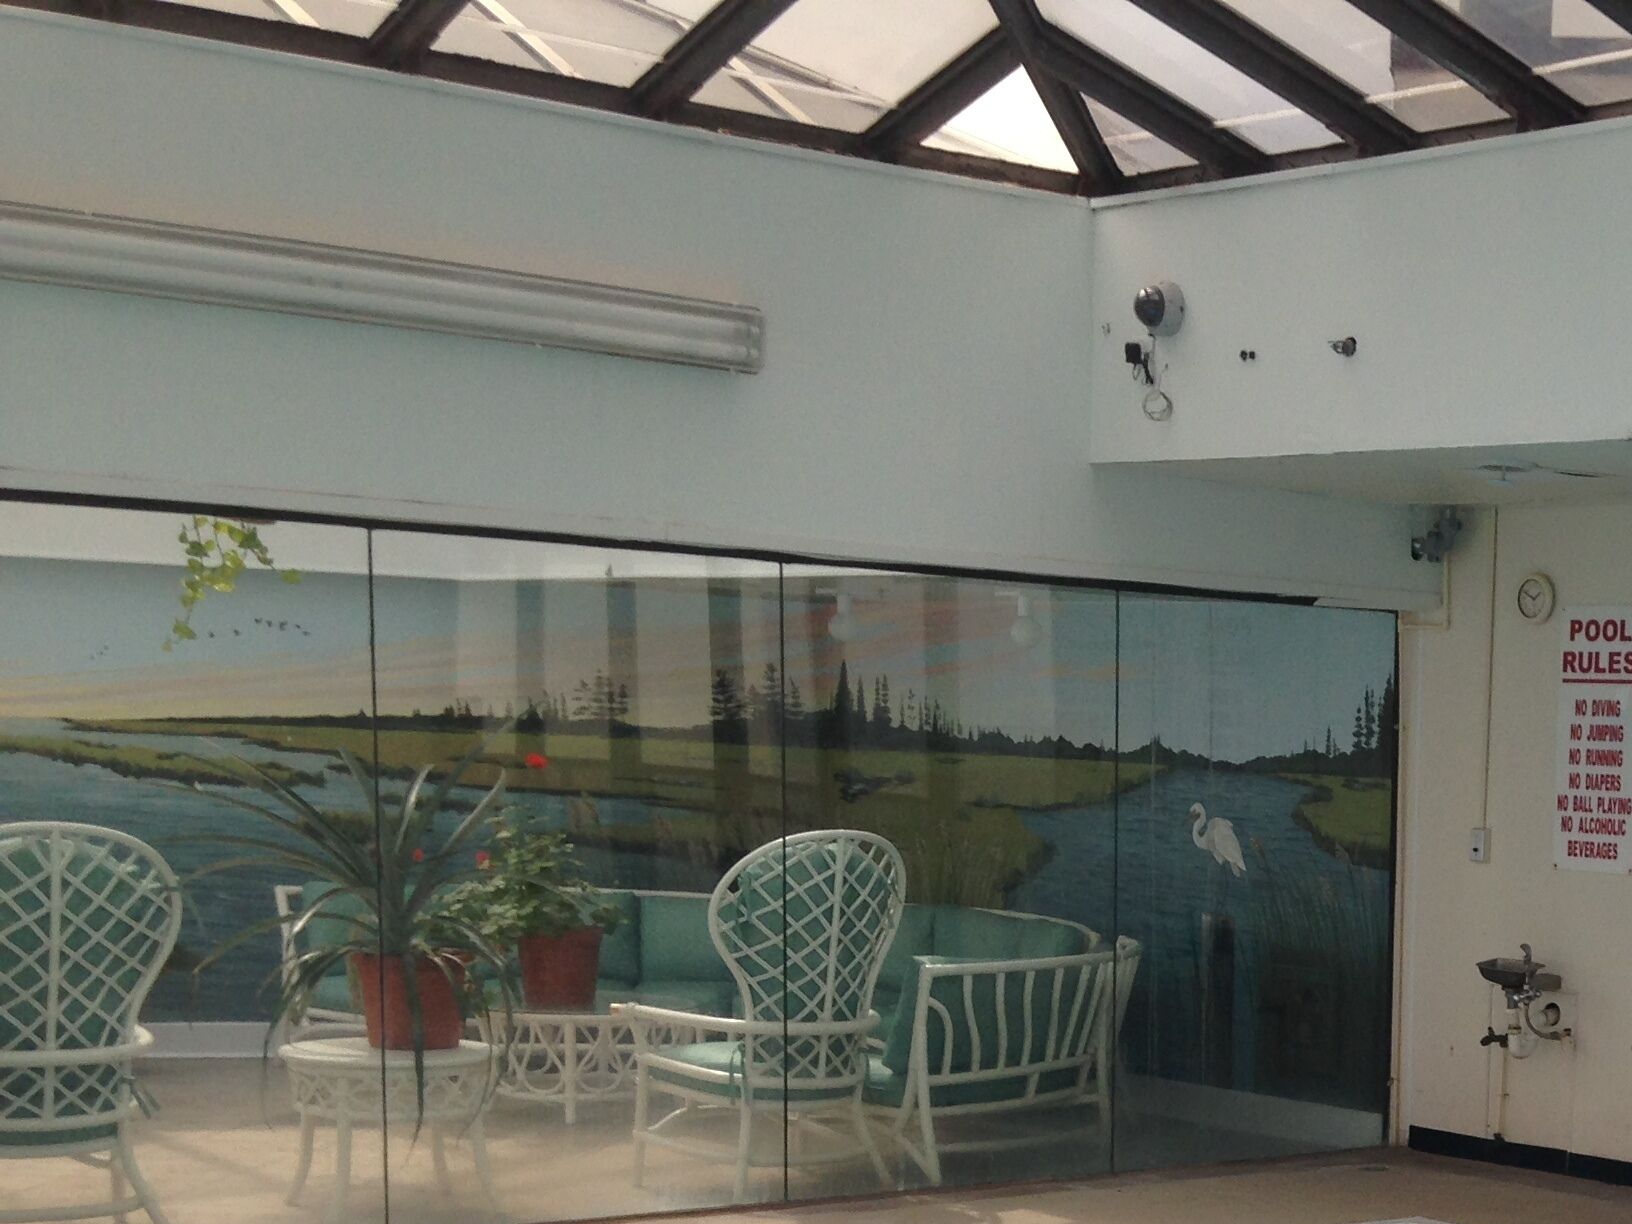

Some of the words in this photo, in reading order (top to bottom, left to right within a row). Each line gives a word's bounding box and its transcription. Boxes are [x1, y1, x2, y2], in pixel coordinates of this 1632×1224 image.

[1569, 619, 1632, 642] POOL
[1575, 699, 1587, 716] NO
[1592, 700, 1621, 717] DIVING
[1570, 724, 1582, 740] NO
[1587, 724, 1624, 742] JUMPING
[1569, 748, 1581, 765] NO
[1585, 749, 1623, 767] RUNNING
[1569, 773, 1581, 789] NO
[1585, 774, 1621, 792] DIAPERS
[1557, 795, 1568, 811] NO
[1573, 796, 1592, 812] BALL
[1597, 797, 1632, 814] PLAYING
[1561, 816, 1572, 832] NO
[1578, 817, 1626, 836] ALCOHOLIC
[1568, 840, 1618, 860] BEVERAGES
